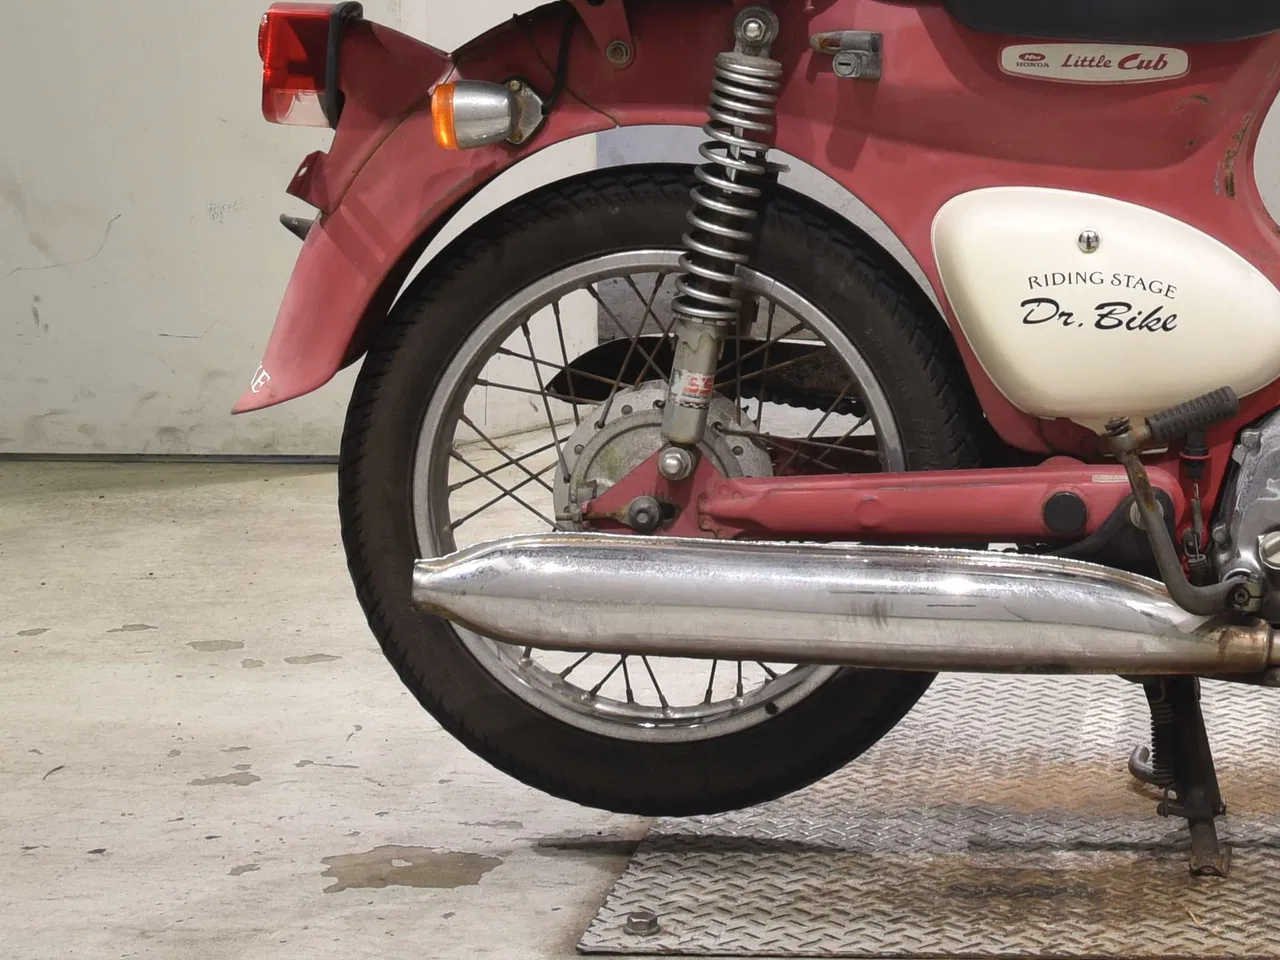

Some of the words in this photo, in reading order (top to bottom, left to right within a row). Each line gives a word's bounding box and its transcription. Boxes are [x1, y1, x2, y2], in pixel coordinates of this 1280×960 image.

[1061, 53, 1112, 68] Little
[1117, 52, 1169, 71] Cub
[1028, 271, 1104, 290] RIDING
[1110, 273, 1178, 300] STAGE
[1020, 297, 1084, 328] Dr.
[1094, 302, 1178, 332] Bike
